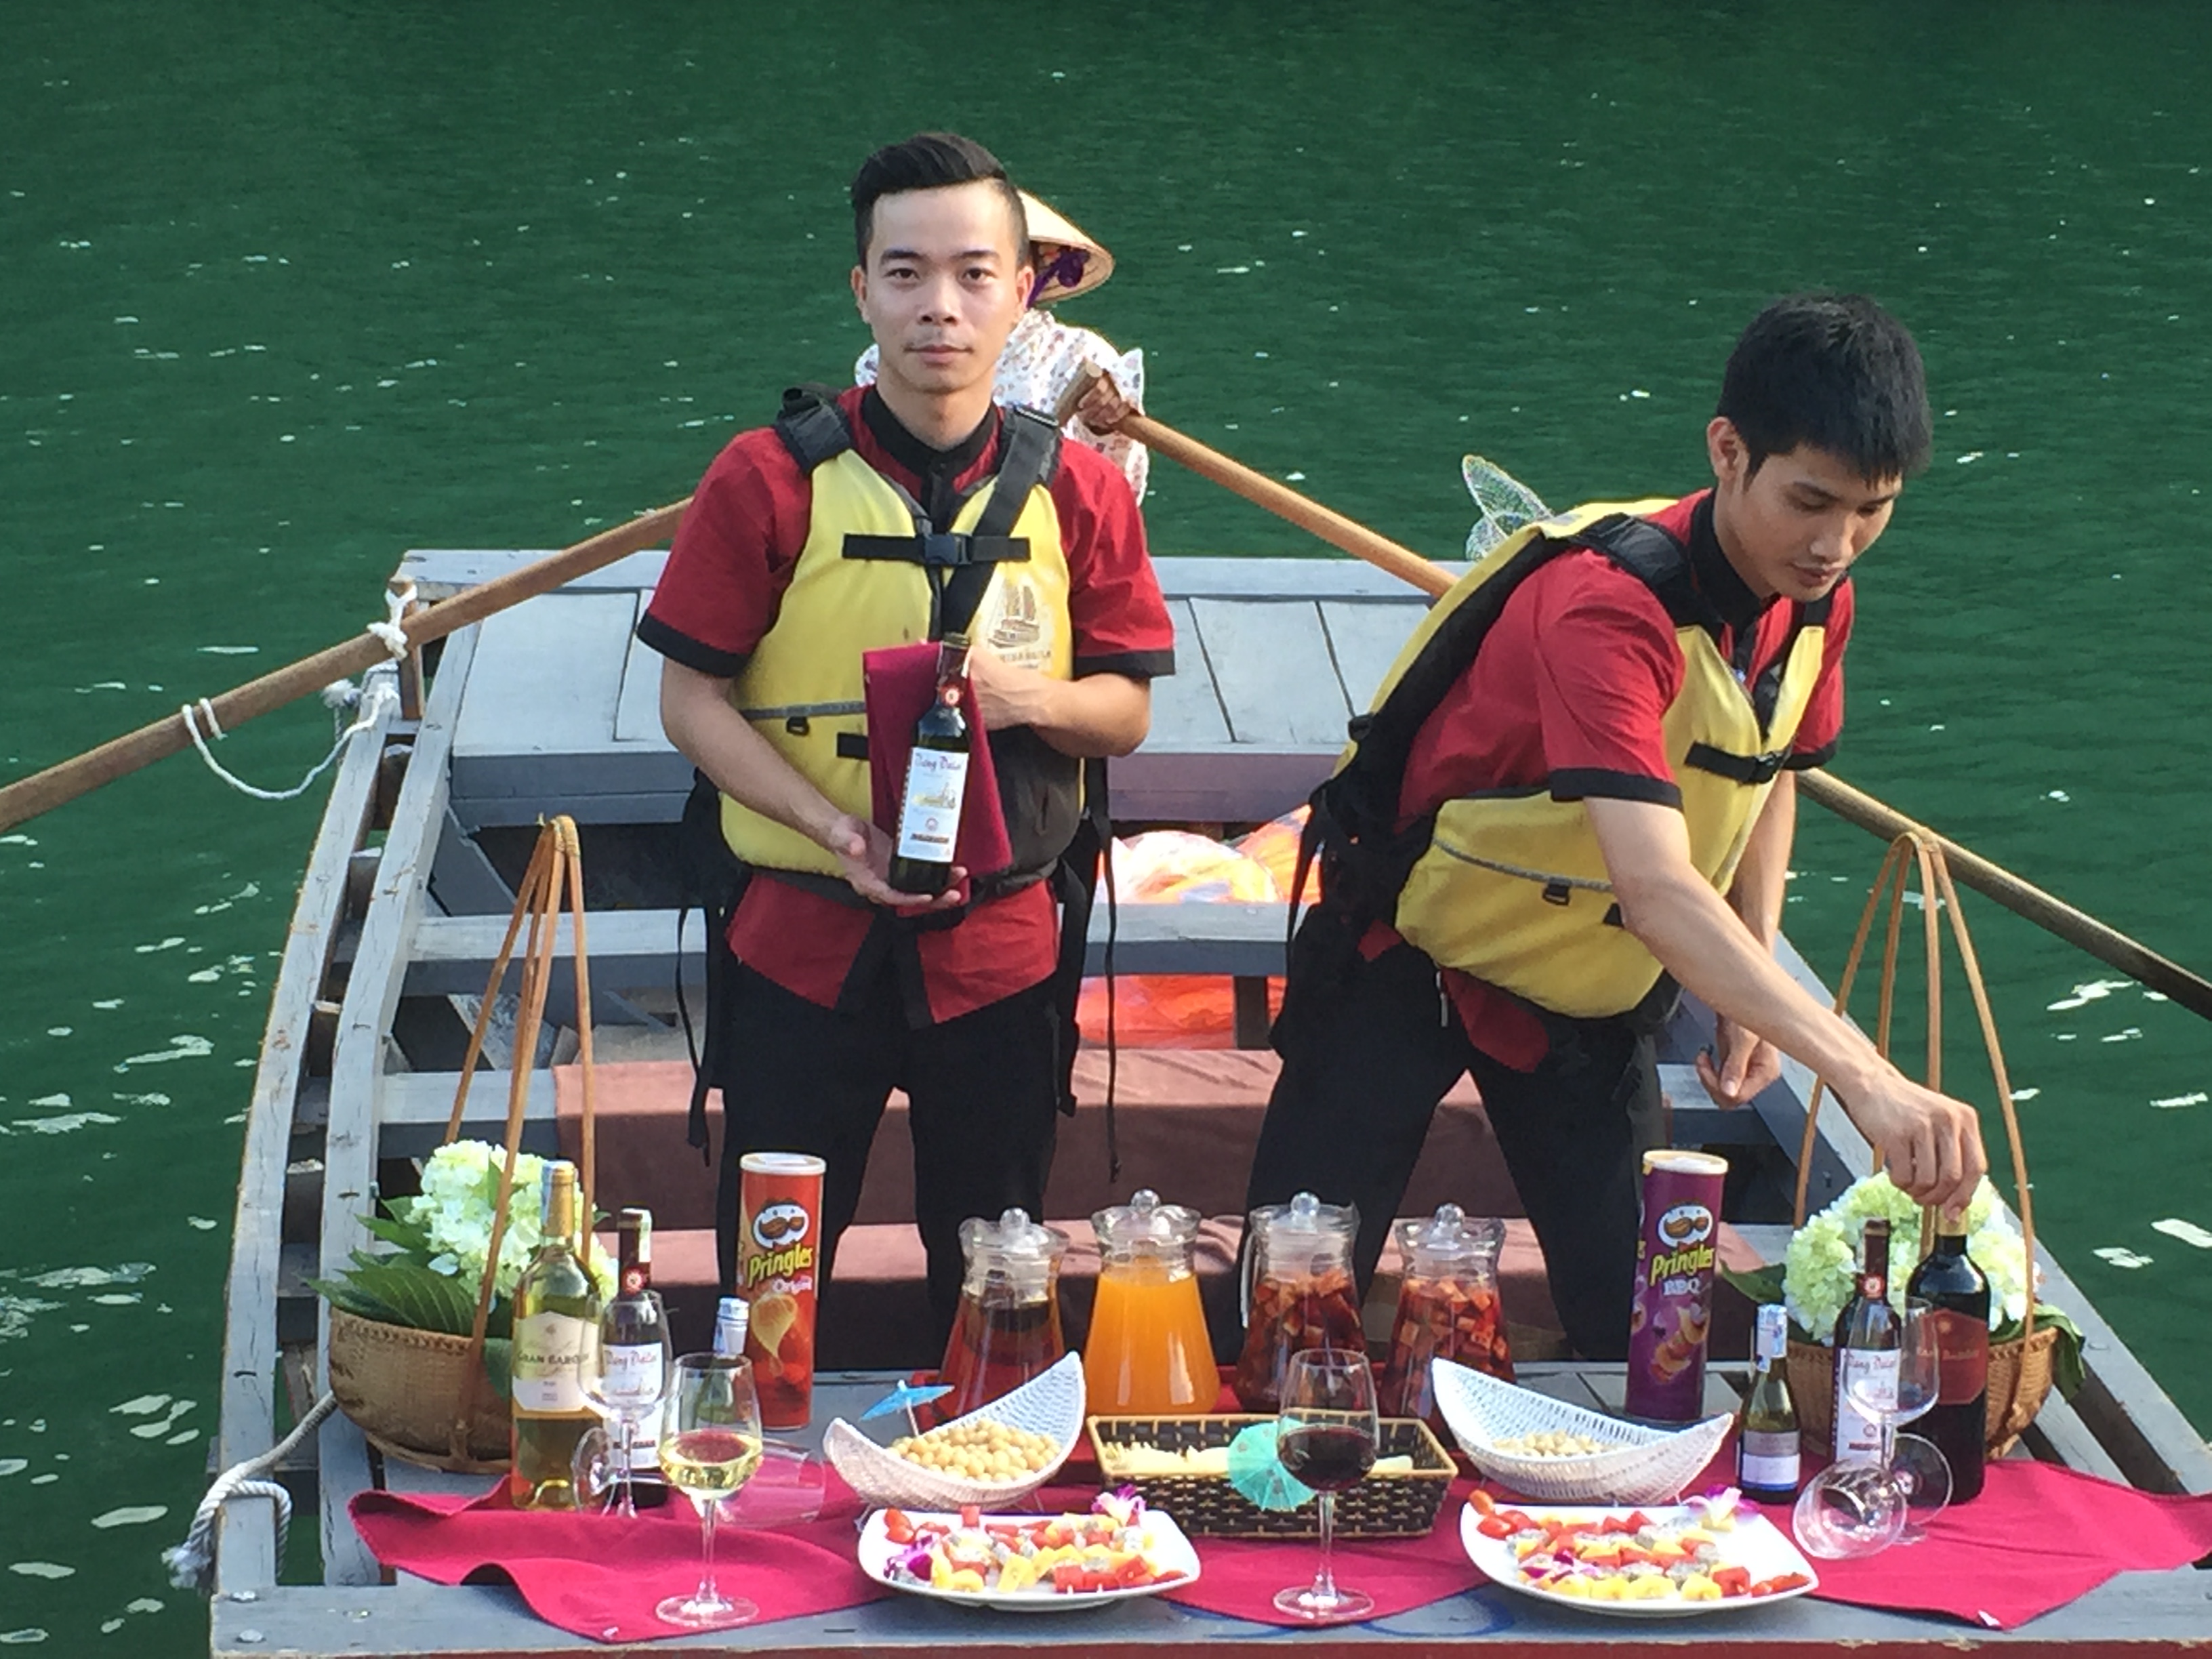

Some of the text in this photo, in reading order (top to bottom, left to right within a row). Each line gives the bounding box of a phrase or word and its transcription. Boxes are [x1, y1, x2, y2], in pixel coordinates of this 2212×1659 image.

[747, 1243, 813, 1289] Pringles
[1649, 1244, 1715, 1287] Pringles
[1663, 1277, 1701, 1296] BBQ
